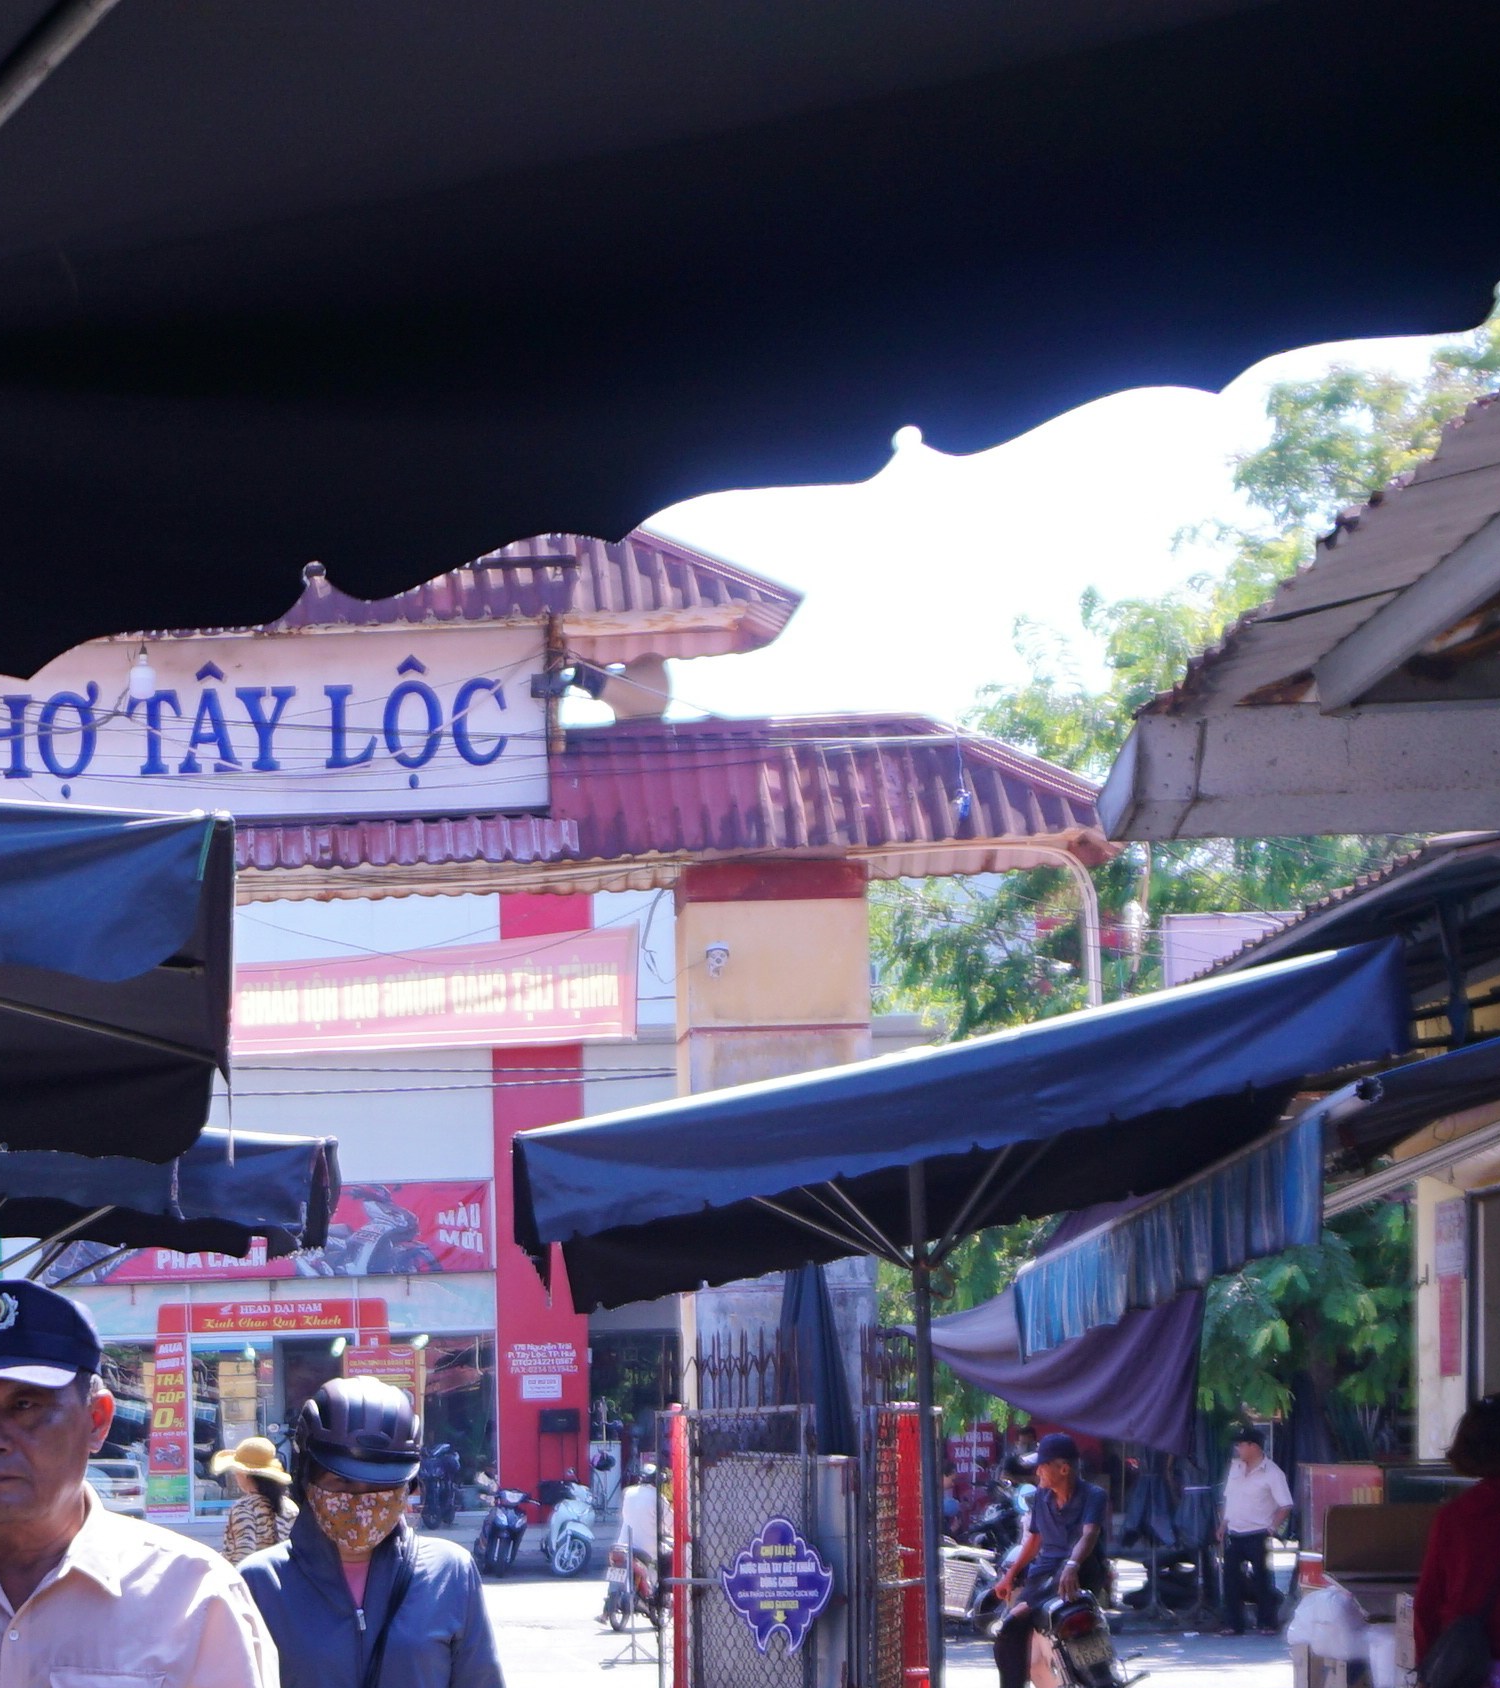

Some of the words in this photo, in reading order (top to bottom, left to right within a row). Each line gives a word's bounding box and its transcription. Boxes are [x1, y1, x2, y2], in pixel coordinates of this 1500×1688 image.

[128, 660, 297, 776] TÂY
[324, 654, 510, 790] LỘC
[438, 1201, 481, 1229] MÀU
[439, 1228, 484, 1253] MỚI
[240, 1305, 271, 1315] HEAD
[274, 1304, 295, 1316] ĐẠI
[298, 1303, 323, 1313] NAM
[158, 1342, 183, 1354] MUA
[156, 1370, 184, 1386] TRẢ
[156, 1389, 186, 1404] GÓP
[153, 1407, 186, 1428] 0%
